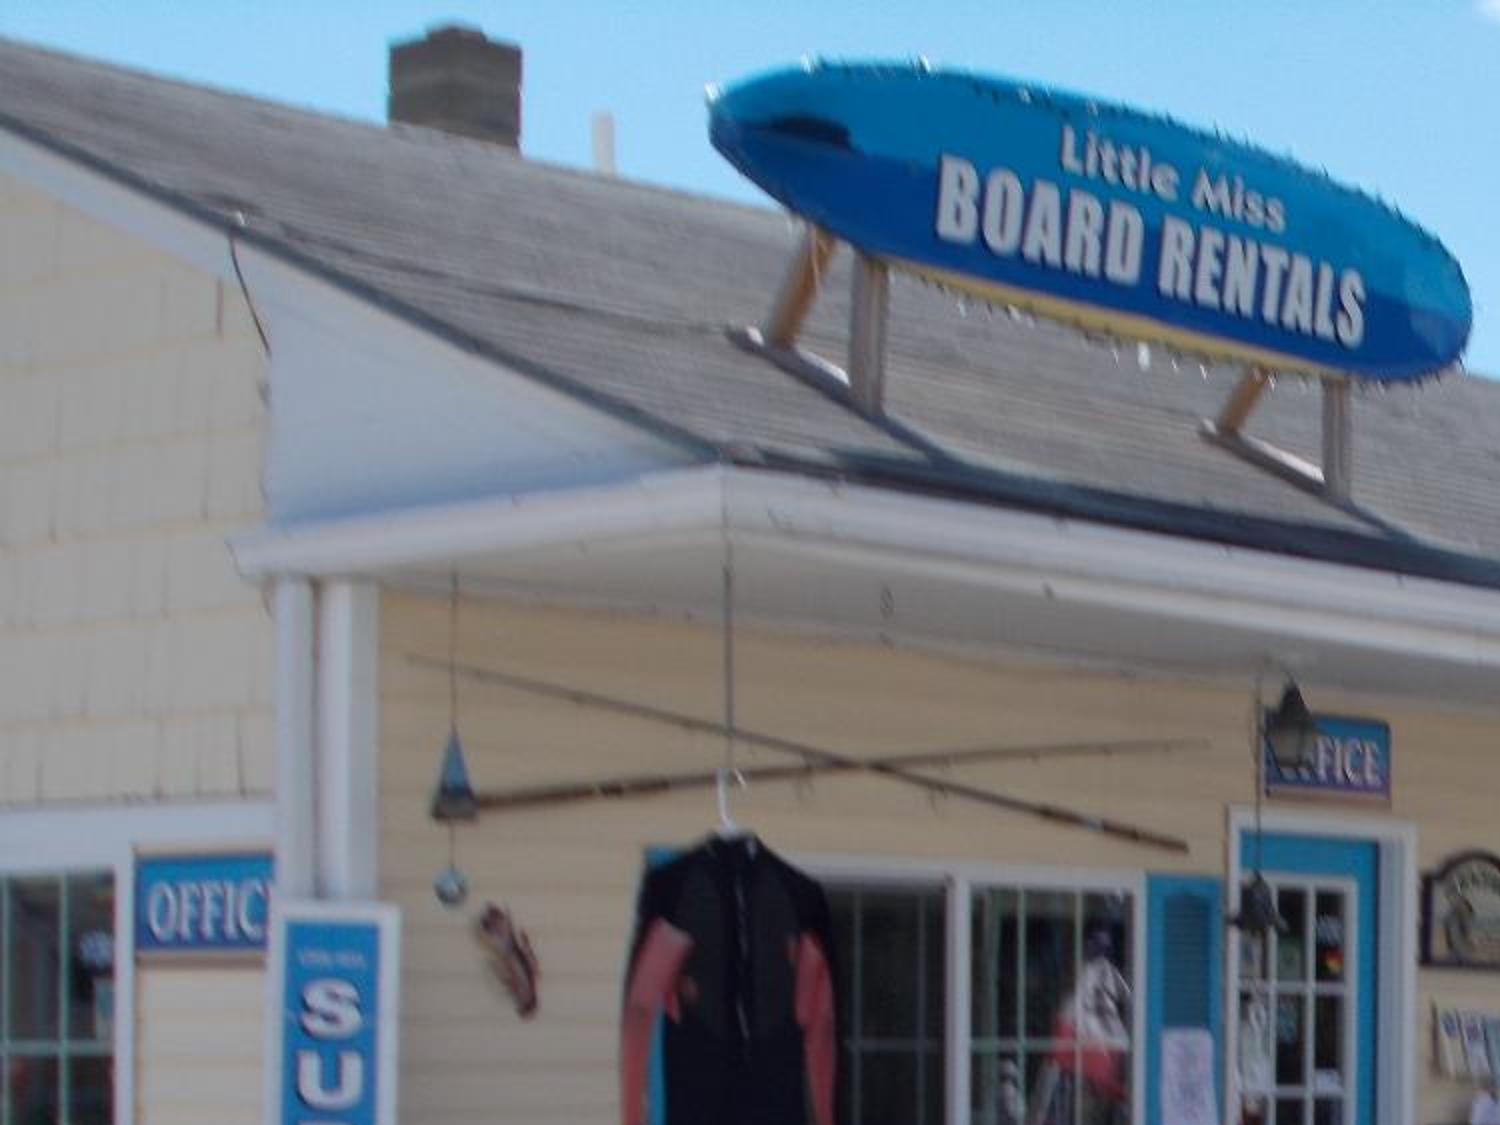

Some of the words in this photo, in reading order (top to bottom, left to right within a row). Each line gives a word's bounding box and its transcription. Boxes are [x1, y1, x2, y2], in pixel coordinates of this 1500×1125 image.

[1060, 124, 1181, 202] Little
[1191, 166, 1286, 235] Miss
[935, 154, 1143, 286] BOARD
[1157, 219, 1367, 349] RENTALS
[1278, 735, 1384, 787] FICE
[148, 879, 272, 943] OFFIC
